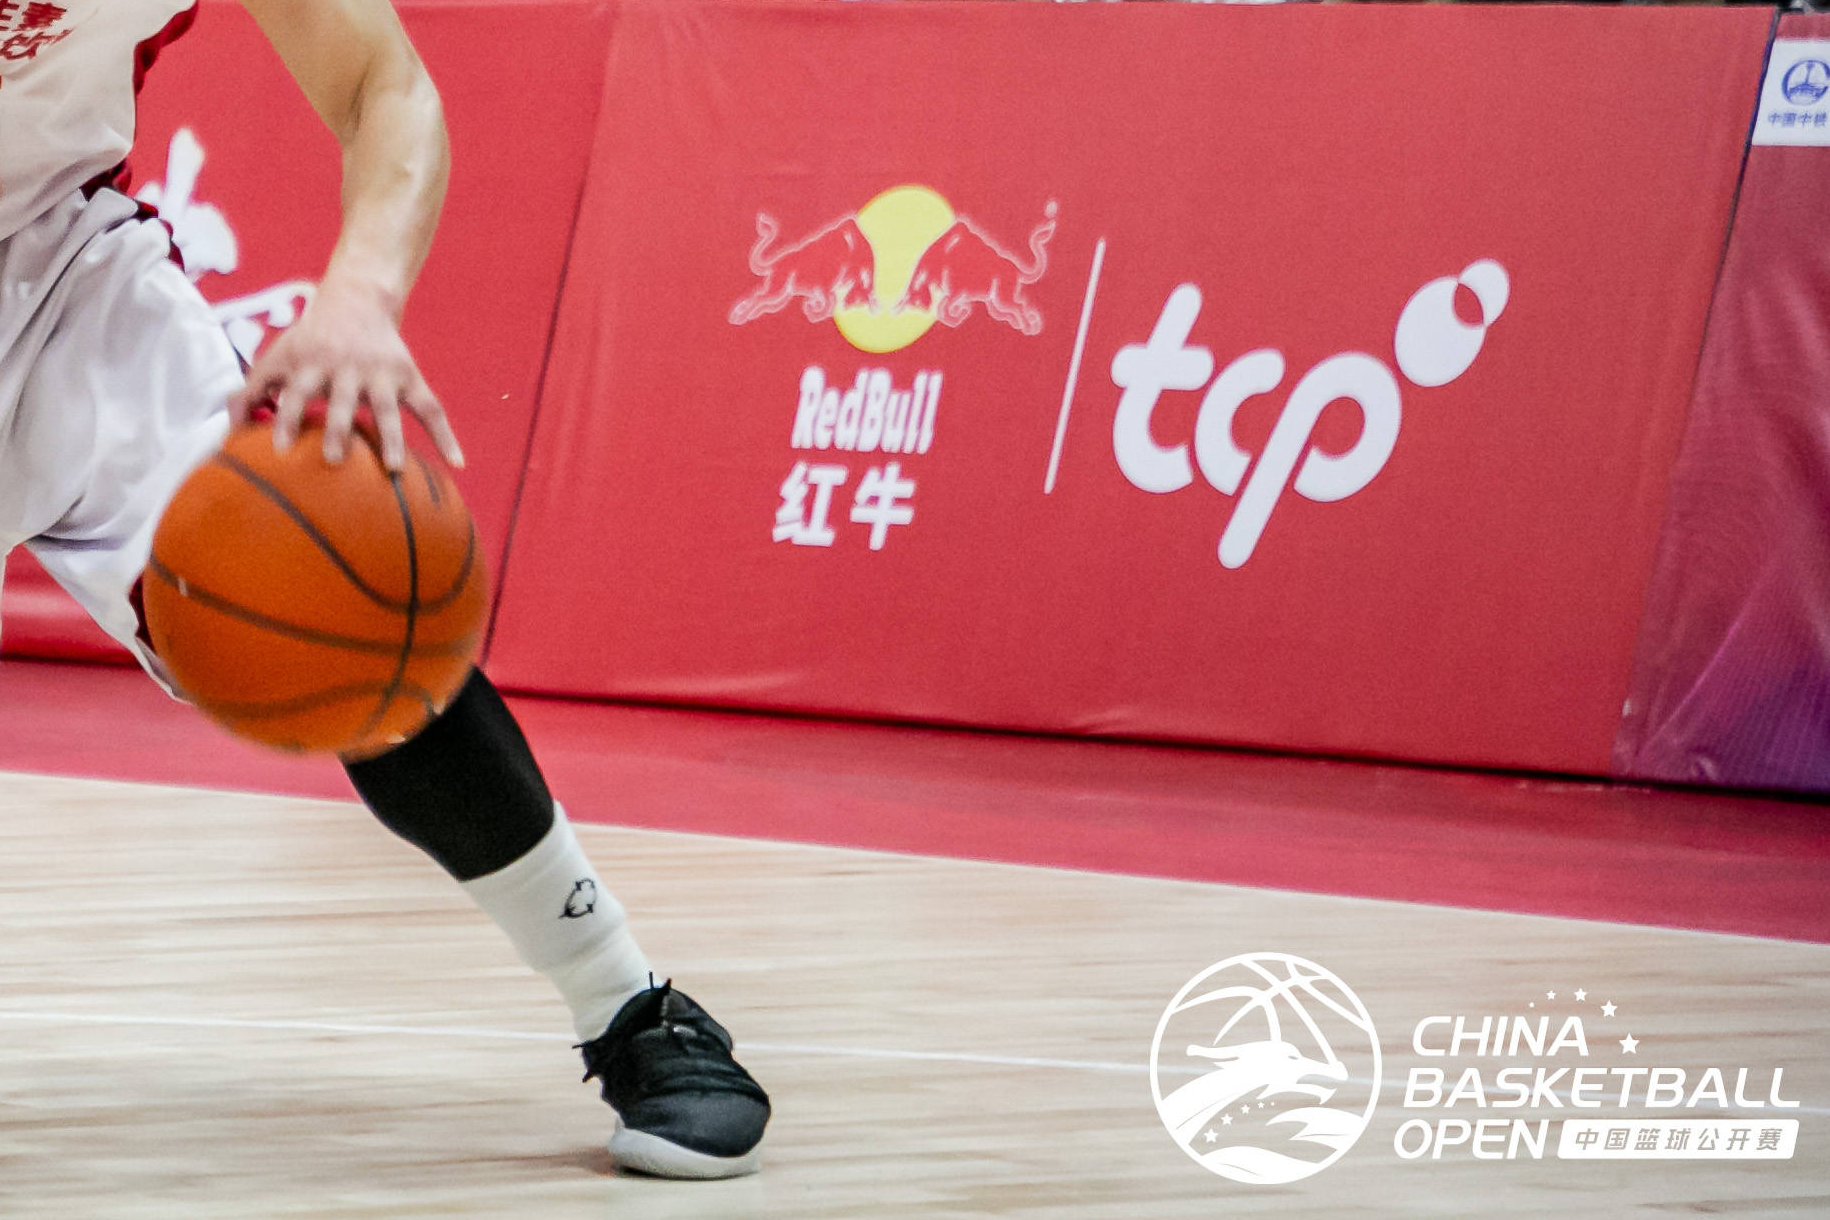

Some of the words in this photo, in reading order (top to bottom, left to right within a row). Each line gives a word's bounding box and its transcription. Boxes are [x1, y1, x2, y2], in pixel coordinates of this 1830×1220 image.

[791, 366, 943, 455] RedBull
[1110, 282, 1402, 569] tcp
[773, 462, 920, 550] 红牛
